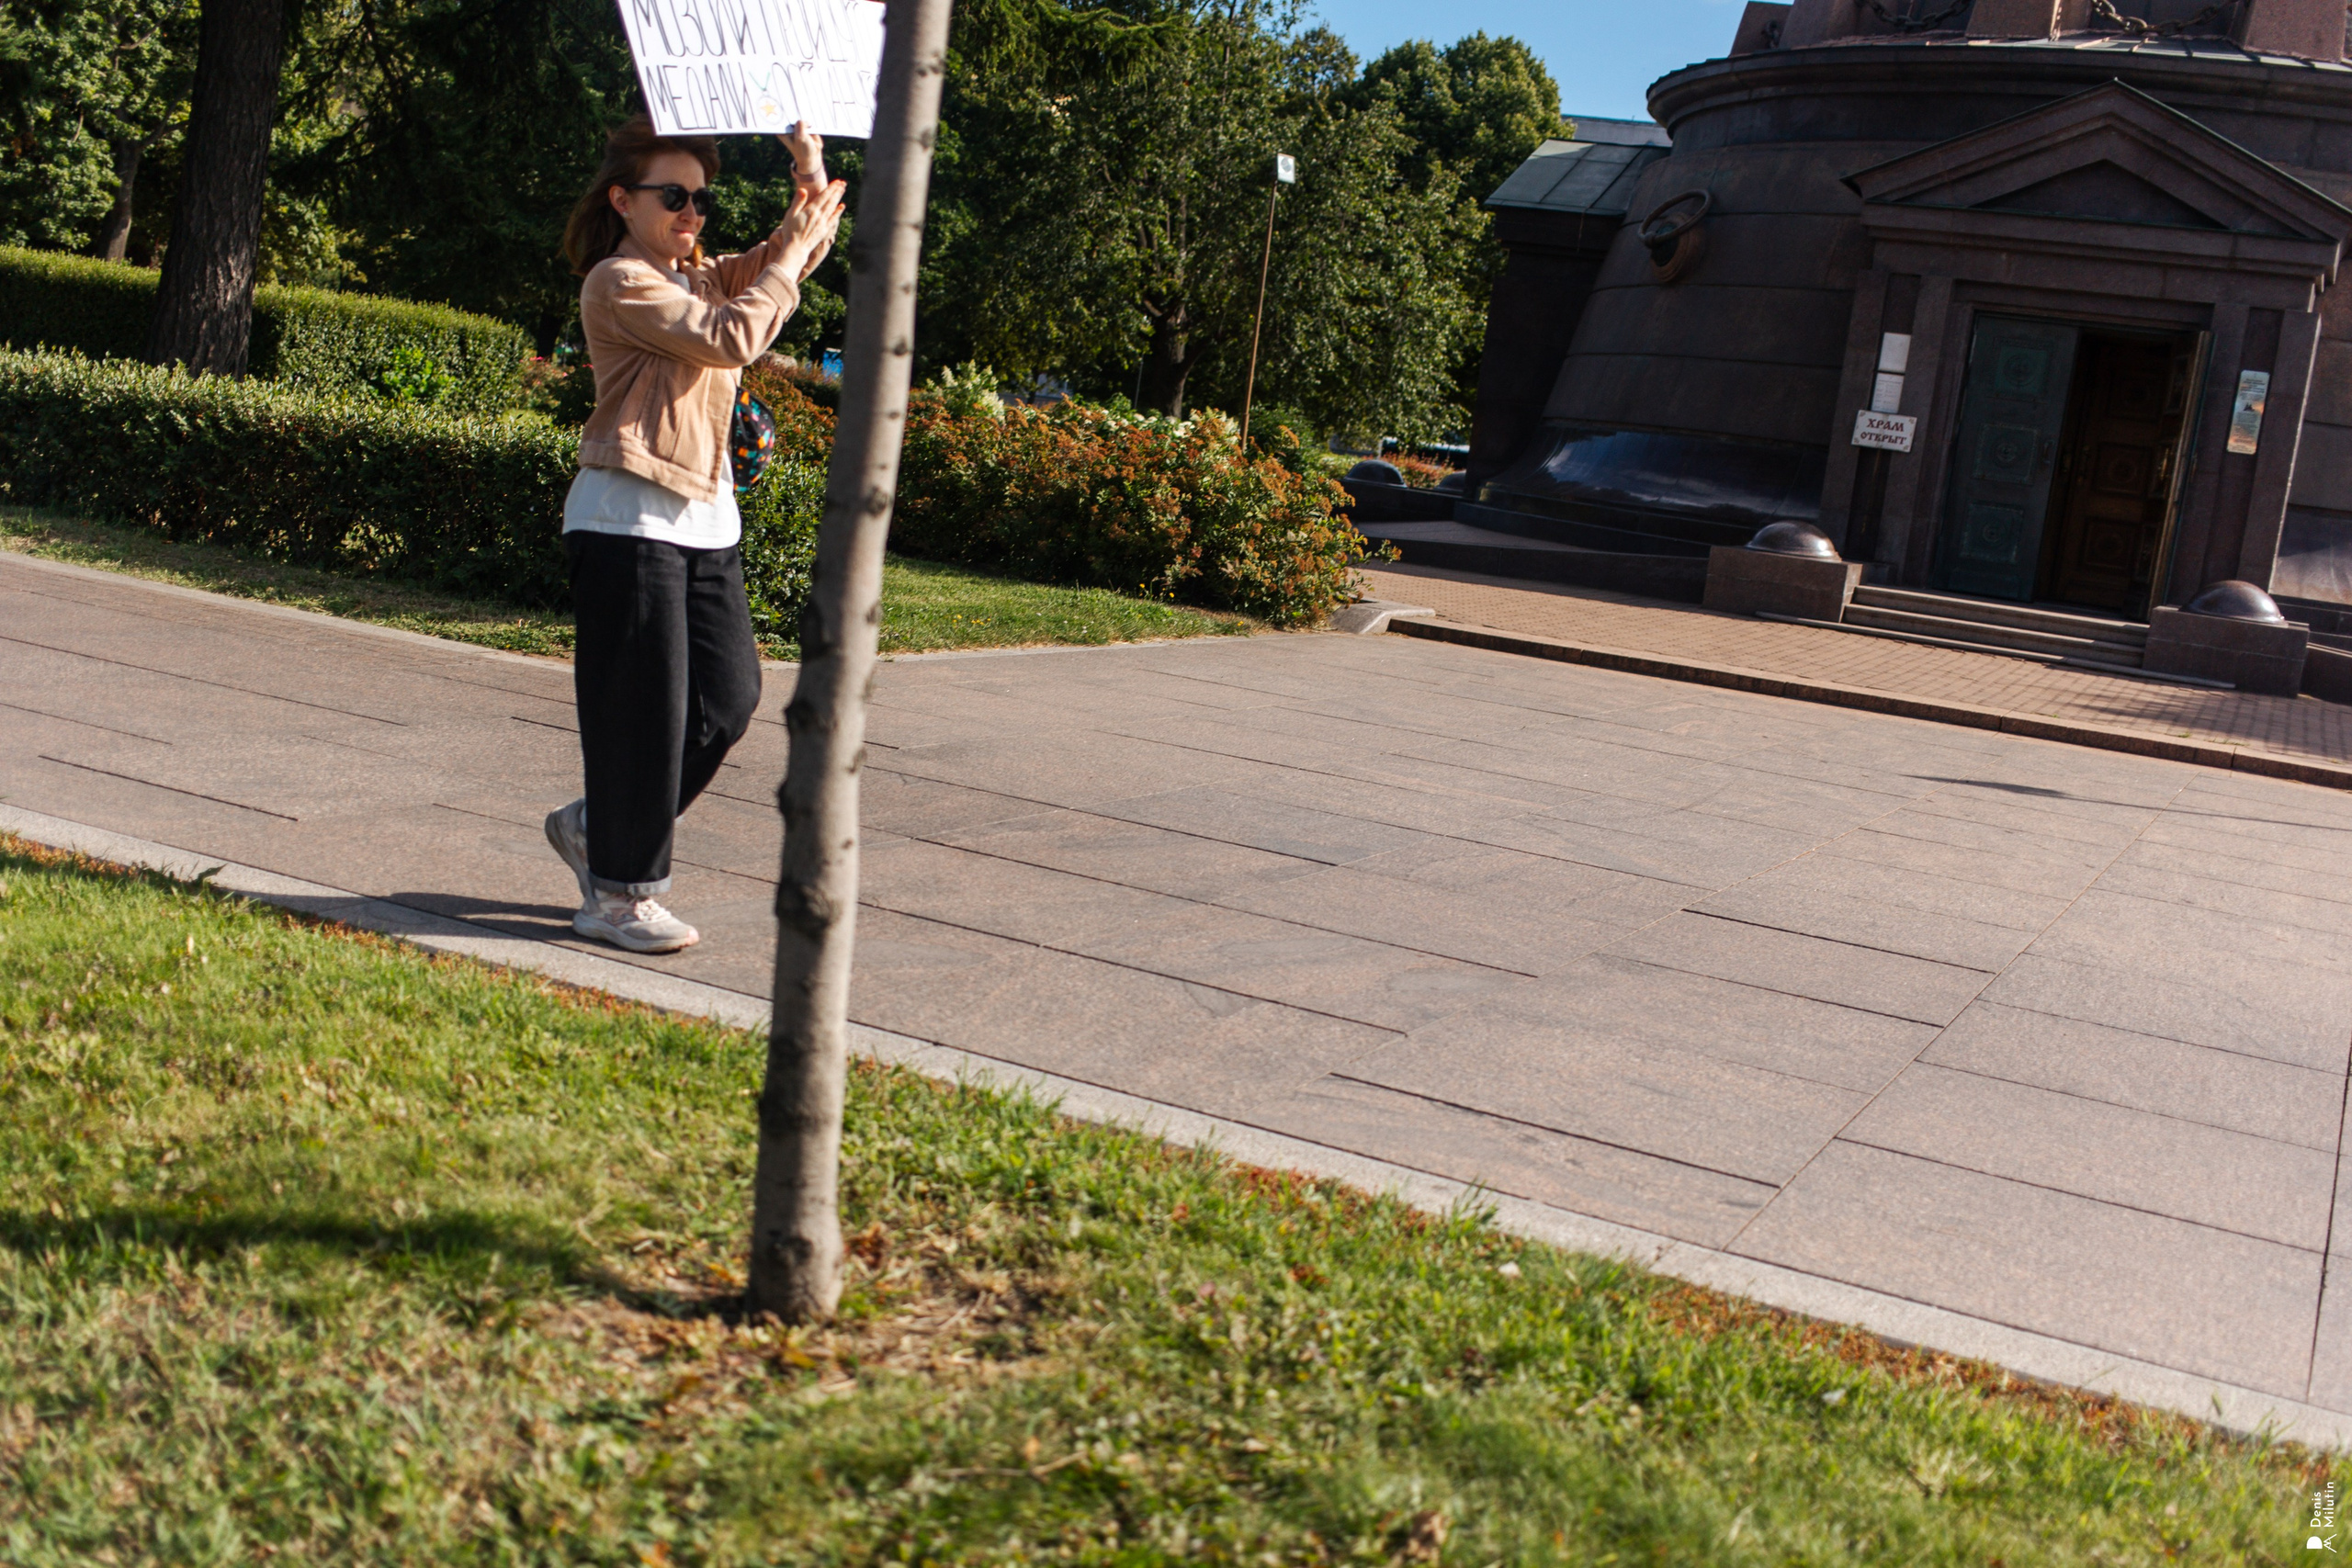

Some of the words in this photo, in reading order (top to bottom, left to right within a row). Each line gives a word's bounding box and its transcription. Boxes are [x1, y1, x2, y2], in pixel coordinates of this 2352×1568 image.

[645, 62, 758, 131] МЕДАЛИ
[1866, 418, 1905, 432] ХРАМ
[1860, 431, 1907, 445] ОТКРЫТ
